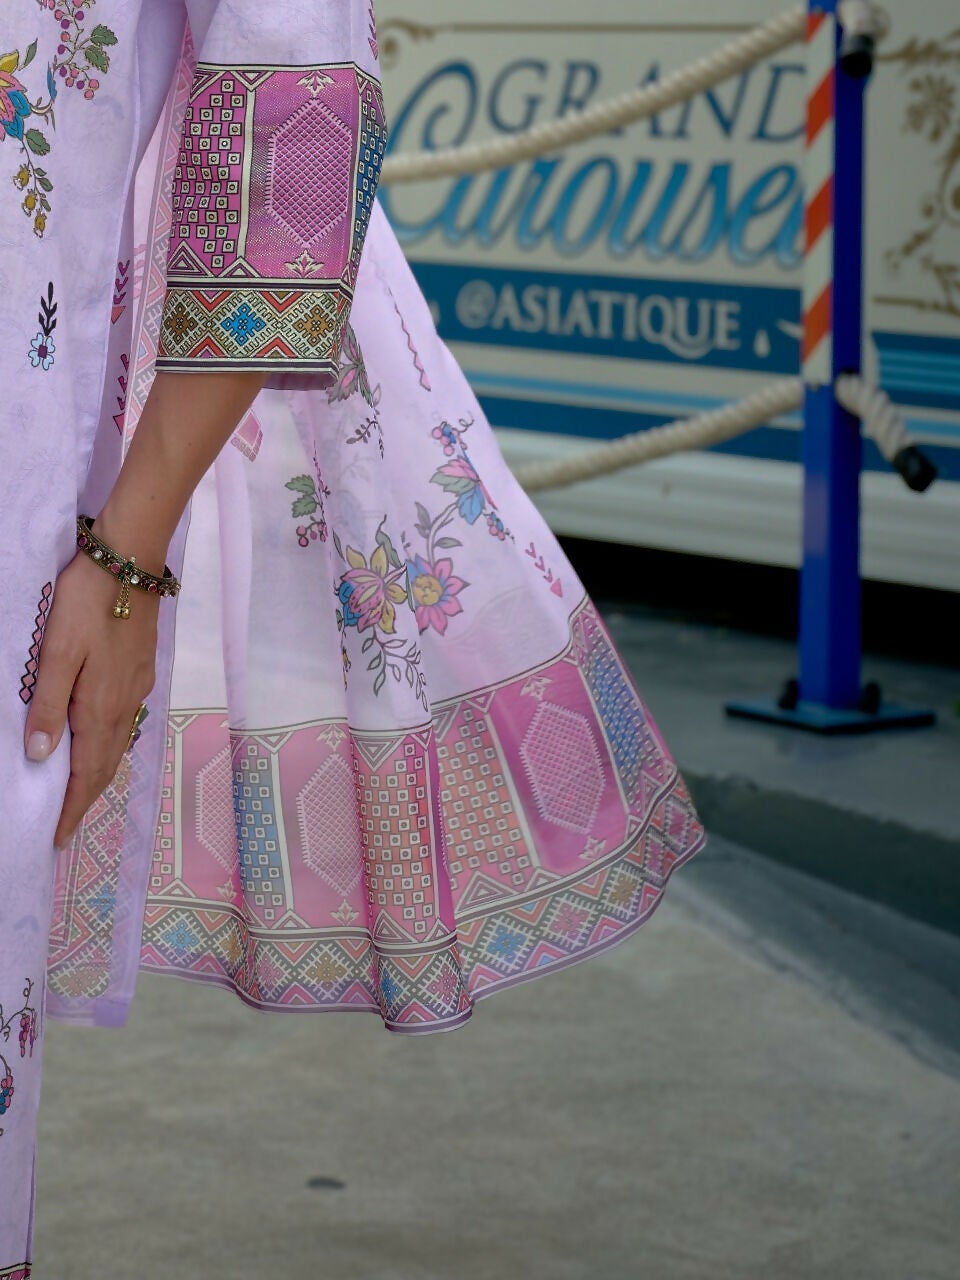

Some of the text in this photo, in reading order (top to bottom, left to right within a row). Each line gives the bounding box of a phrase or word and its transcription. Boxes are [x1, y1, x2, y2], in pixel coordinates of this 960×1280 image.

[487, 57, 806, 143] GRAND
[376, 57, 806, 268] Carouse
[455, 279, 741, 360] @ASIATIQUE
